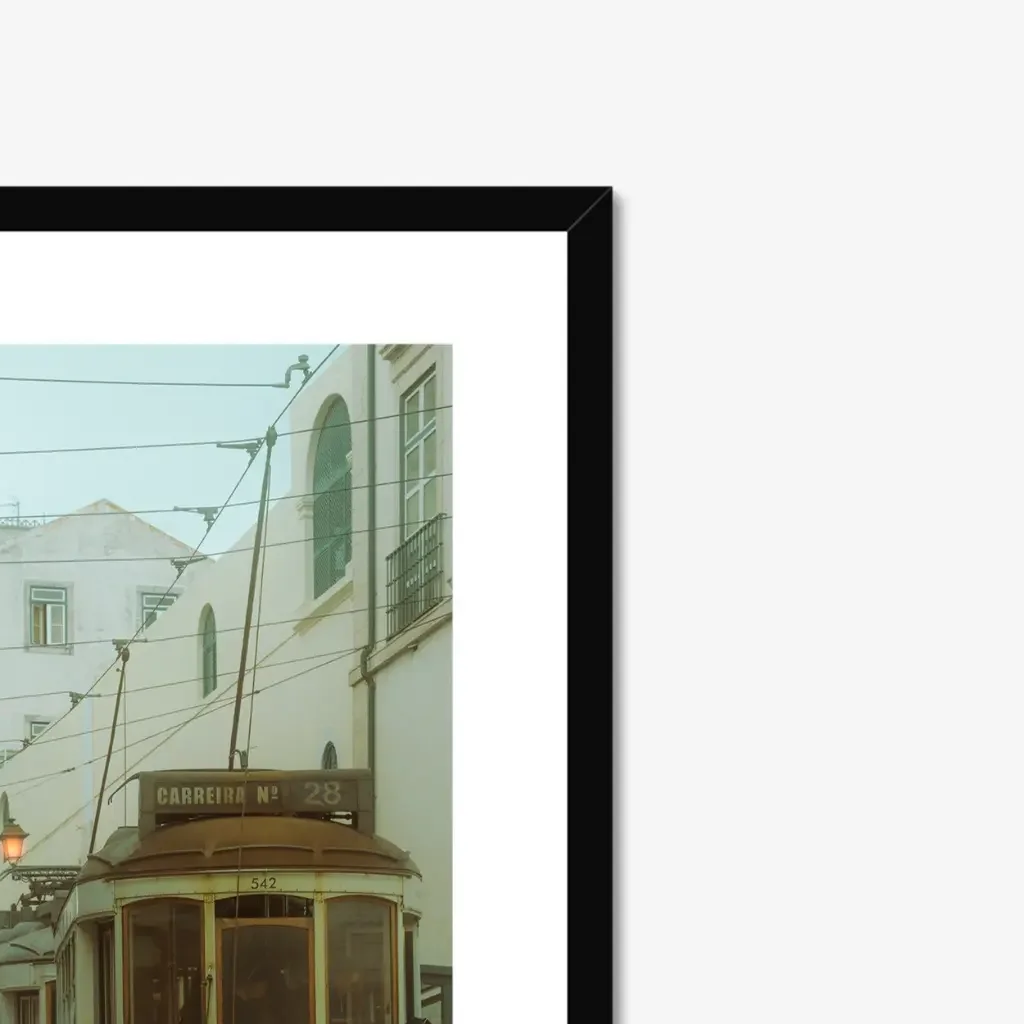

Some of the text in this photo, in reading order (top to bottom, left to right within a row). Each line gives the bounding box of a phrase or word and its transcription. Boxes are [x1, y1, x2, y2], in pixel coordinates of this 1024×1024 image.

[156, 786, 245, 805] CARREIRA
[303, 780, 342, 807] 28
[251, 877, 277, 890] 542
